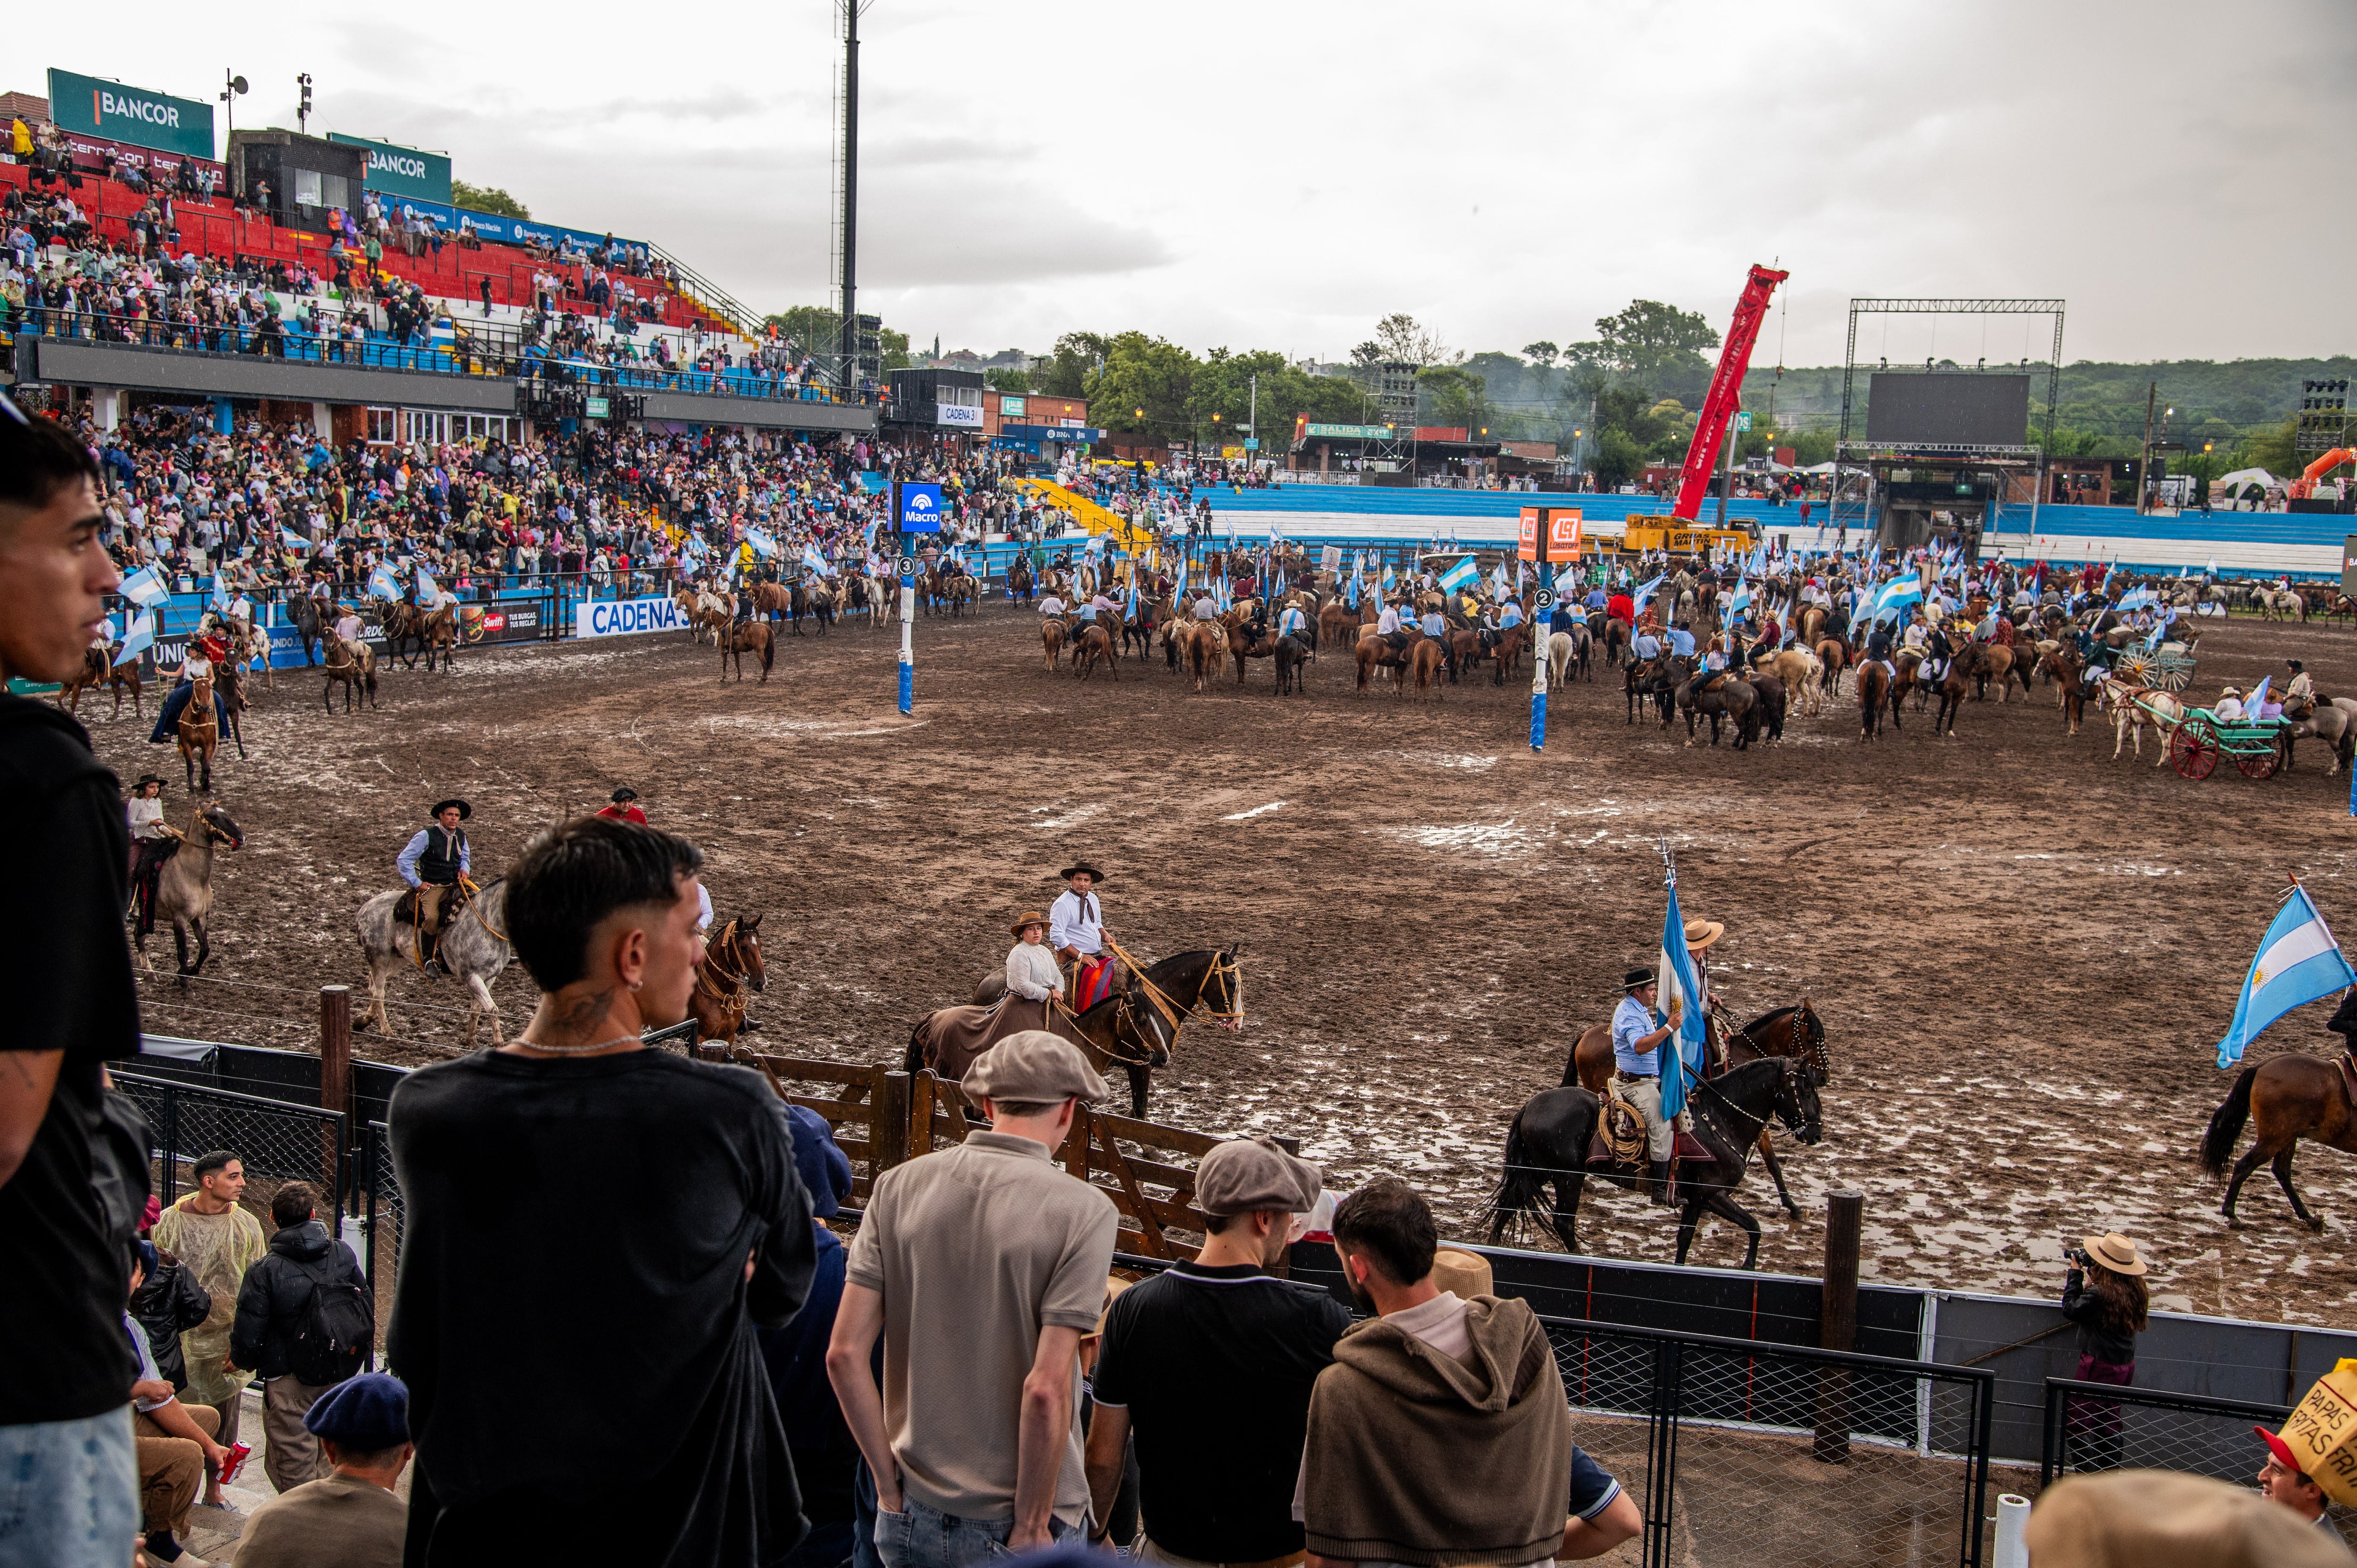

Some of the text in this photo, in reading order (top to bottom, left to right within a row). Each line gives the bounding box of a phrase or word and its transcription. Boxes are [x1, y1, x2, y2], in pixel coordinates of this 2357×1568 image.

[102, 92, 180, 128] BANCOR
[368, 150, 426, 179] BANCOR
[470, 220, 502, 233] Banco Nación
[946, 408, 975, 421] CADENA 3
[1320, 425, 1388, 436] SALIDA EXIT
[905, 511, 938, 523] Macro
[903, 561, 910, 571] 3
[1540, 593, 1548, 604] 2
[484, 616, 504, 627] Swift
[593, 599, 678, 634] CADENA
[2306, 1388, 2349, 1430] PAPAS
